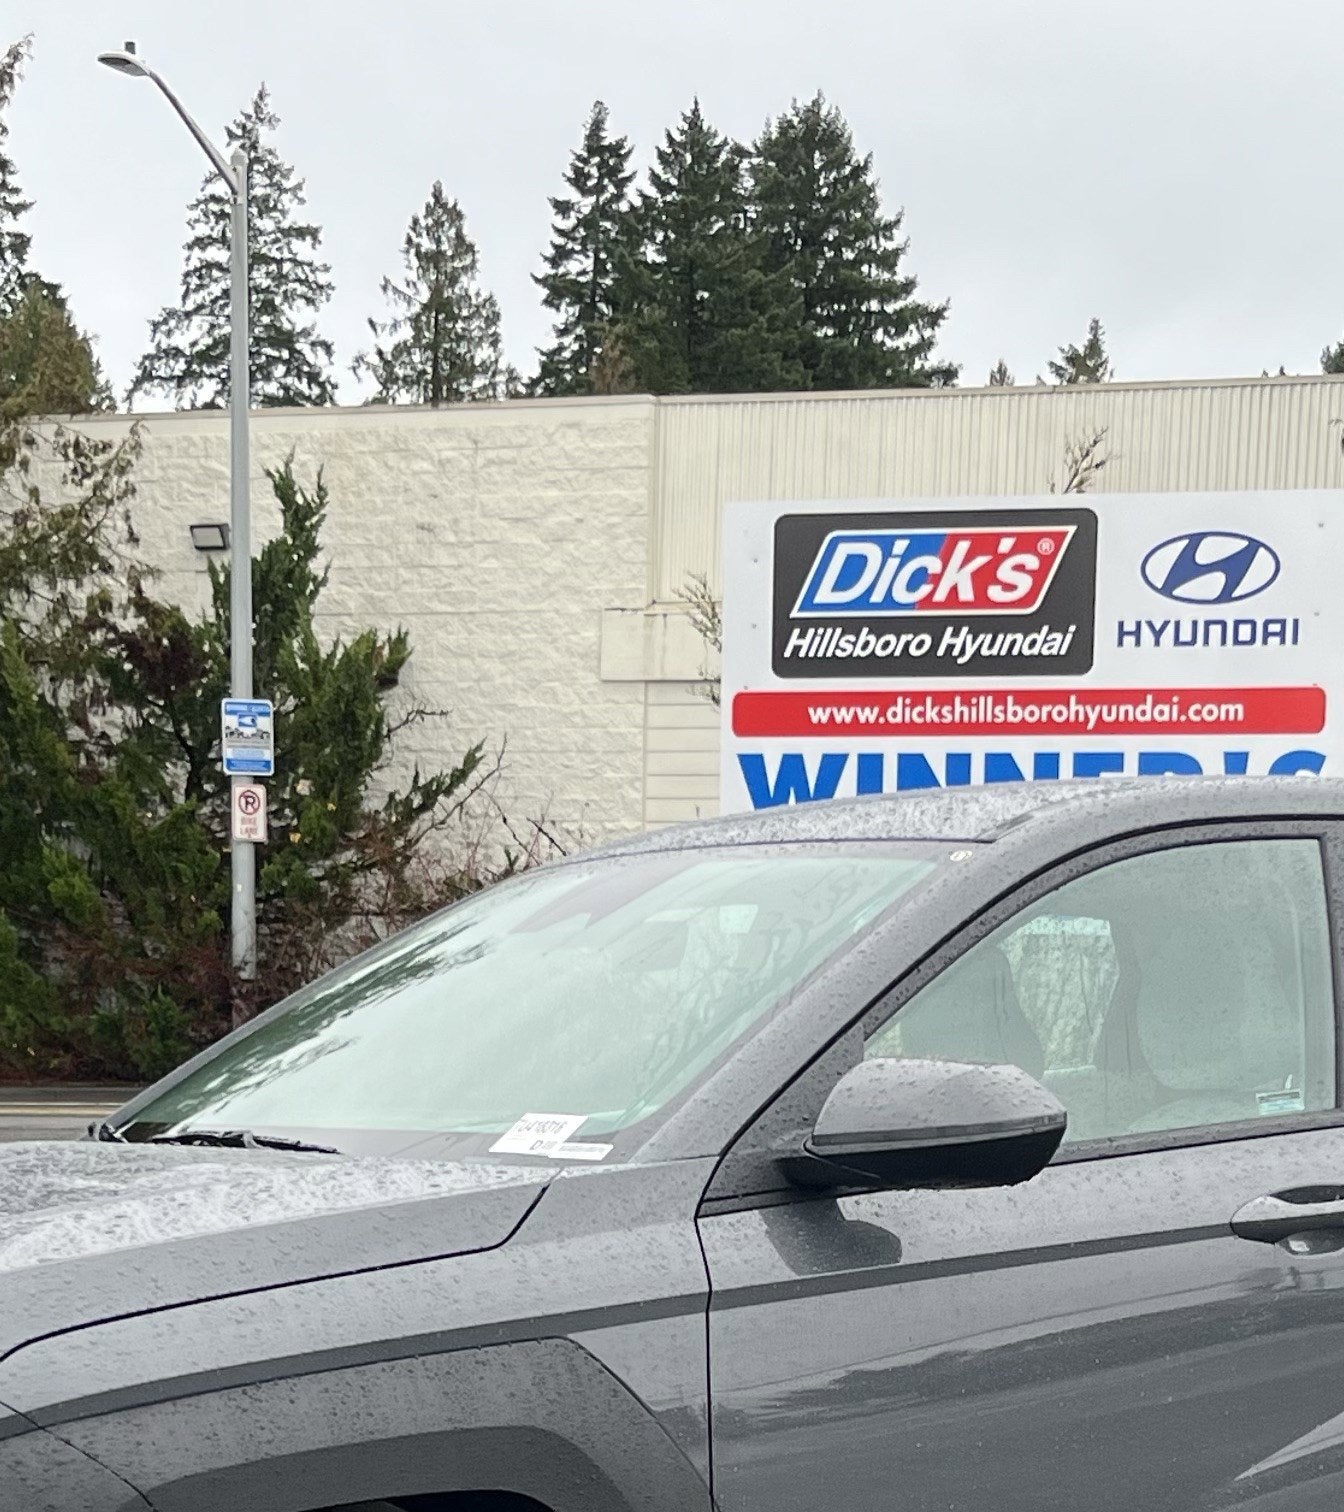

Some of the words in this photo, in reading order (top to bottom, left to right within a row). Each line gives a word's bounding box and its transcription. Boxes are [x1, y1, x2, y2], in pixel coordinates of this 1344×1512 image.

[813, 537, 1040, 604] Dick's
[783, 626, 932, 659] Hillsboro
[936, 625, 1075, 664] Hyundai
[1117, 617, 1299, 649] HYUNDAI
[807, 696, 1245, 731] www.dickshillsborohyundai.com
